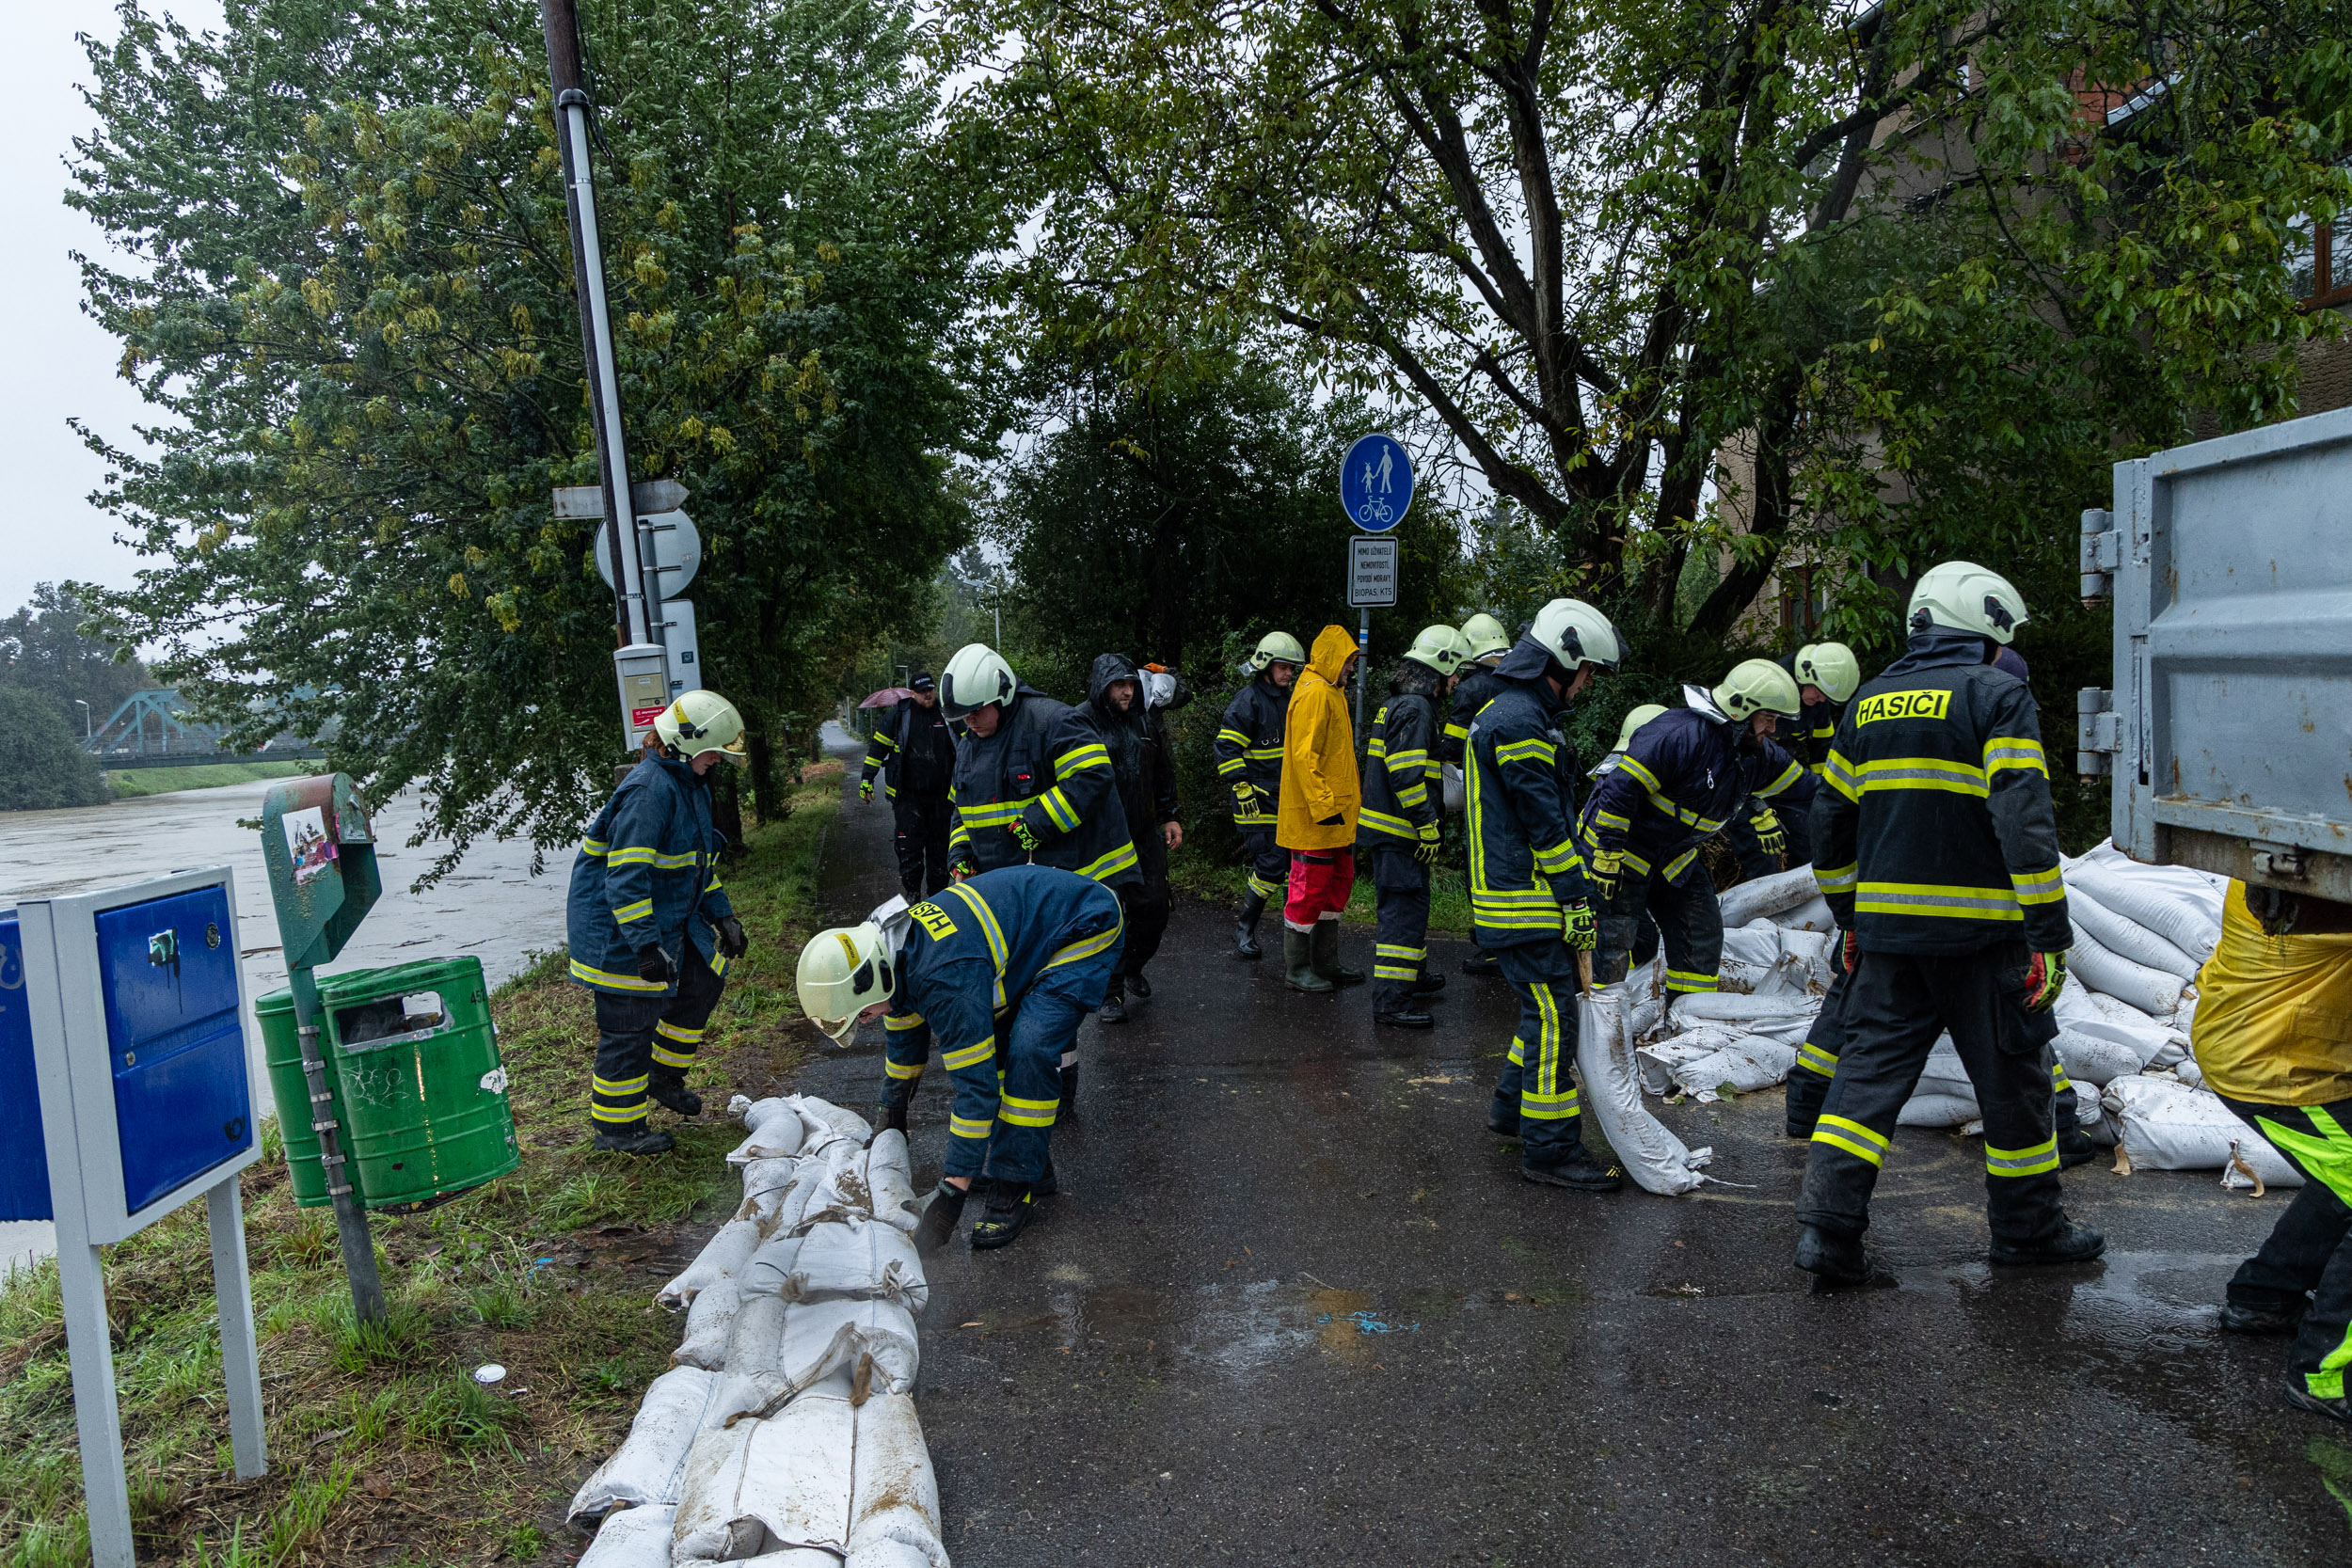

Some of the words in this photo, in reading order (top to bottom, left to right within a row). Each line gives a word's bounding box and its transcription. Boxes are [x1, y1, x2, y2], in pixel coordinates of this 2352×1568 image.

[1358, 547, 1369, 556] MIMO
[1371, 546, 1392, 556] UŽIVATELŮ
[1357, 573, 1373, 583] POVODÍ
[1380, 588, 1392, 596] KTS
[1859, 691, 1945, 724] HASIČI
[909, 902, 952, 933] HASI
[470, 988, 486, 1005] 452
